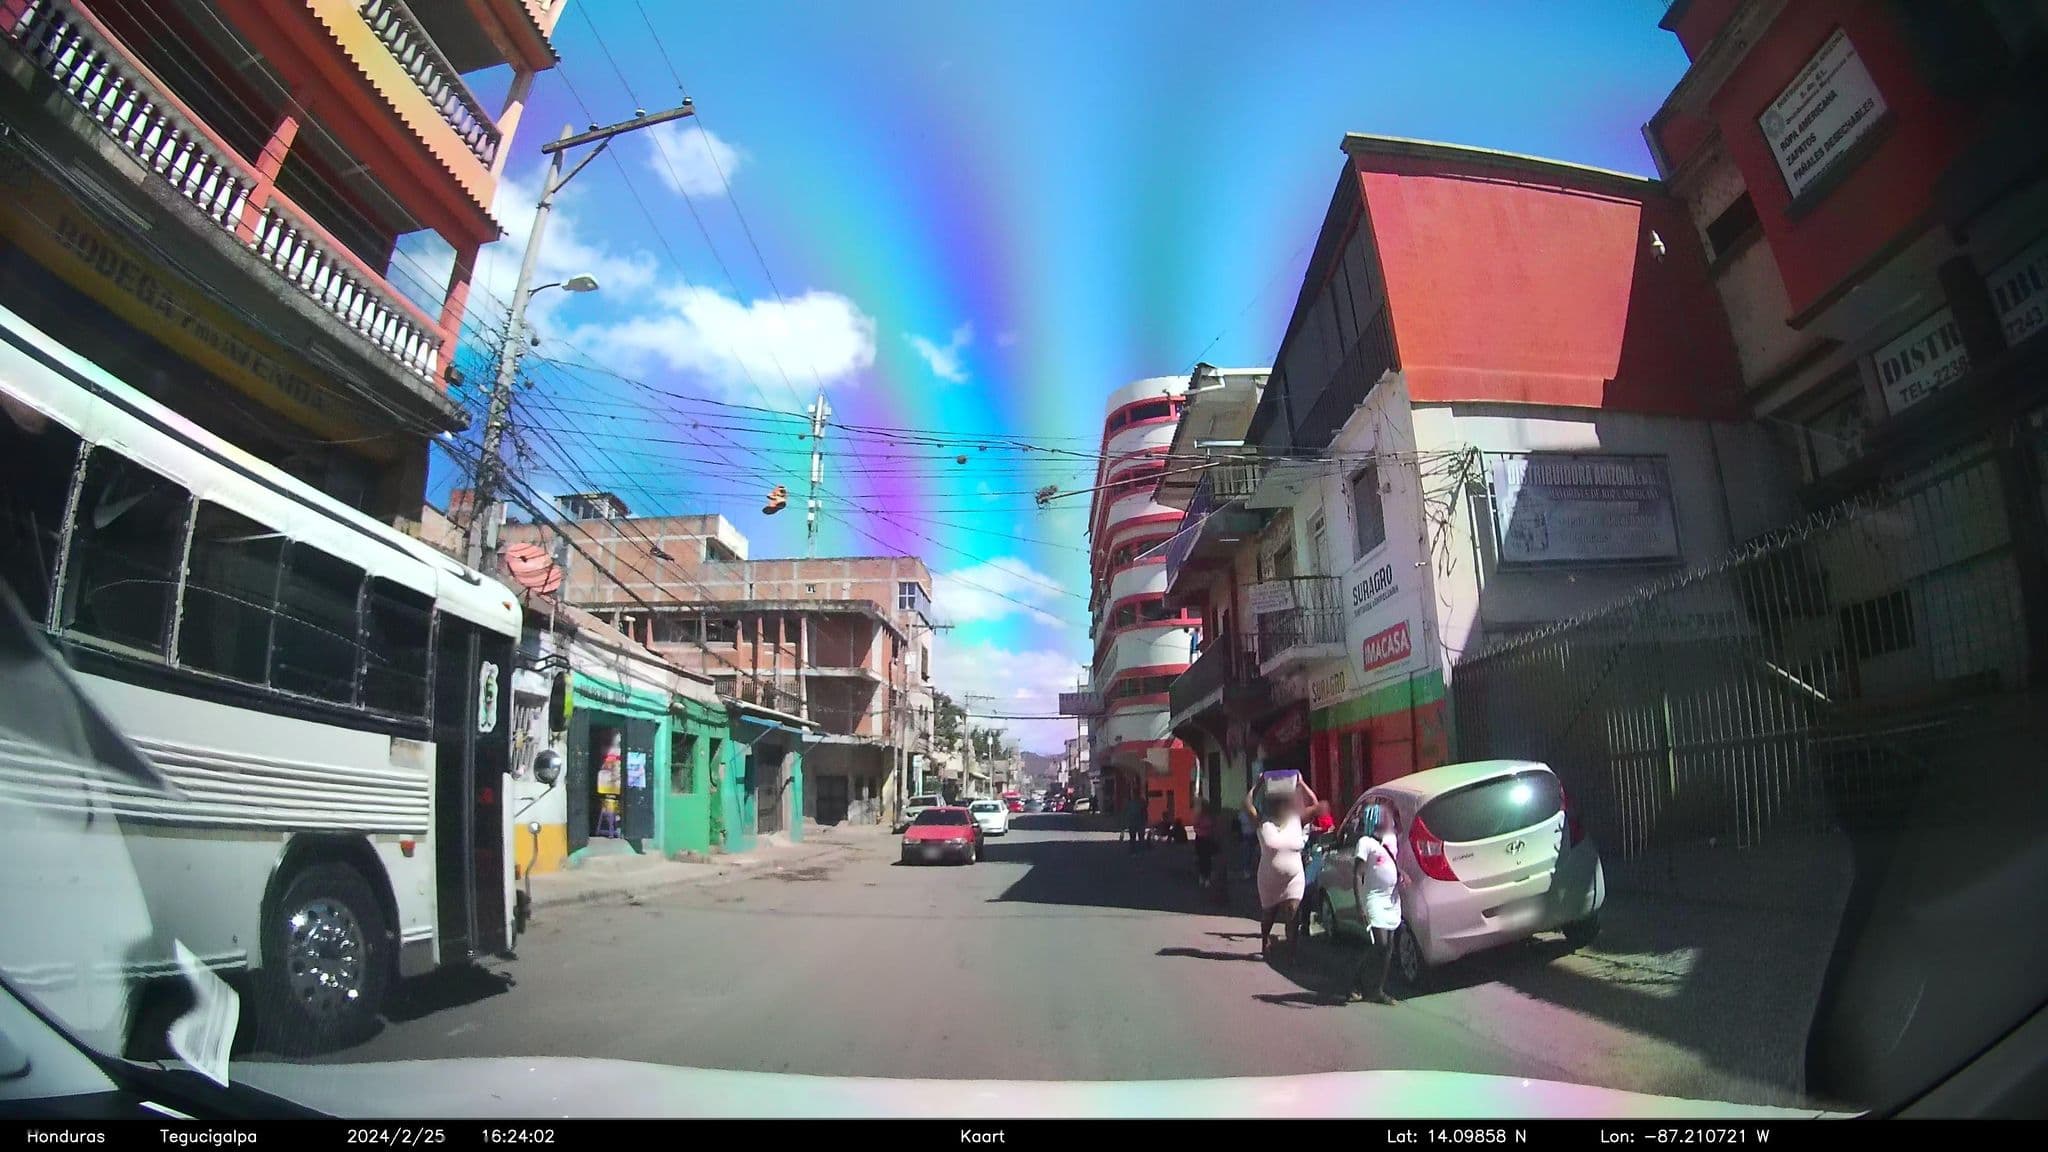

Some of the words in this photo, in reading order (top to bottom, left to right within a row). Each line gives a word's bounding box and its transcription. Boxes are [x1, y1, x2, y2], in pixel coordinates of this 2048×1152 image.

[1779, 132, 1800, 152] ROPA
[1798, 89, 1838, 134] AMERICANA
[1793, 148, 1825, 182] PAÑALES
[1824, 96, 1875, 153] DESECHABLES
[1785, 132, 1817, 167] ZAPATOS
[57, 212, 173, 318] BODEGA
[1507, 463, 1593, 486] DISTRIBUIDORA
[1593, 463, 1637, 486] ARIZONA
[1352, 563, 1393, 607] SURAGRO
[1364, 628, 1411, 665] IMACASA
[1311, 671, 1346, 703] SURAGRO
